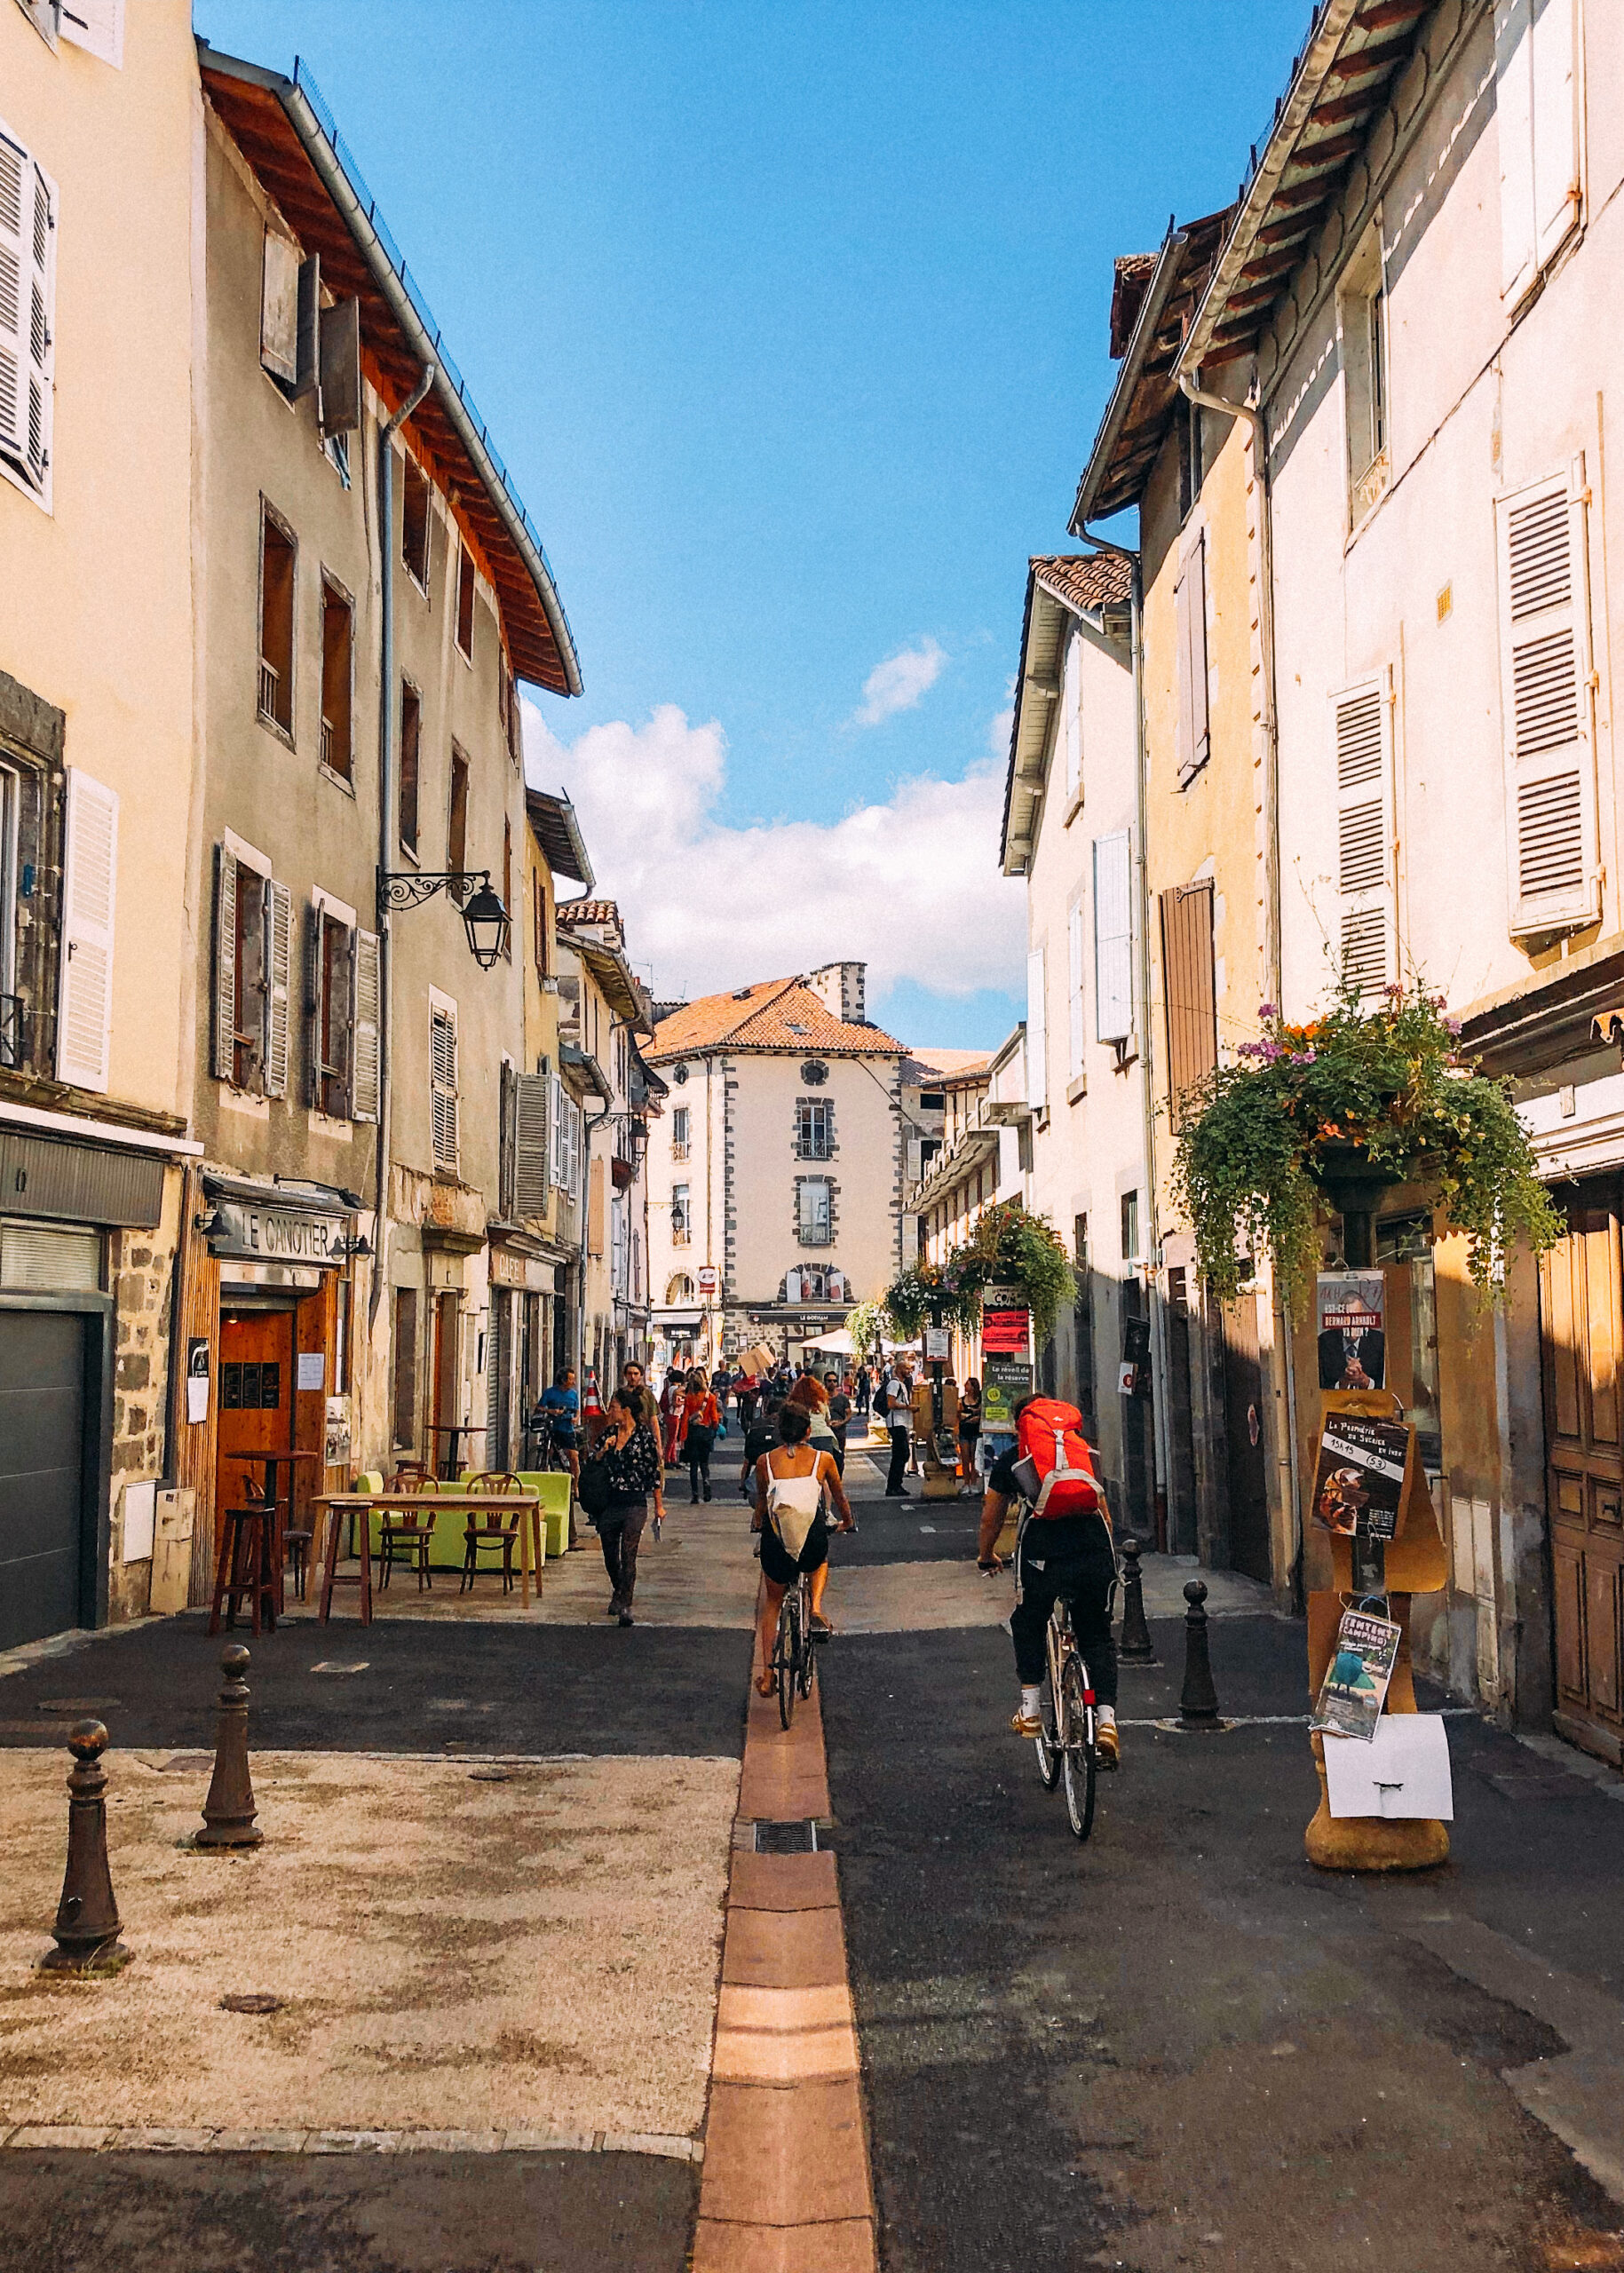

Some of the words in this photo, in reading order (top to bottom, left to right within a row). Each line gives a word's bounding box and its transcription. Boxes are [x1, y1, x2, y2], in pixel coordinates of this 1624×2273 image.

[242, 1213, 258, 1248] LE
[265, 1217, 329, 1256] CANOTIER
[1325, 1316, 1351, 1327] BERNARD
